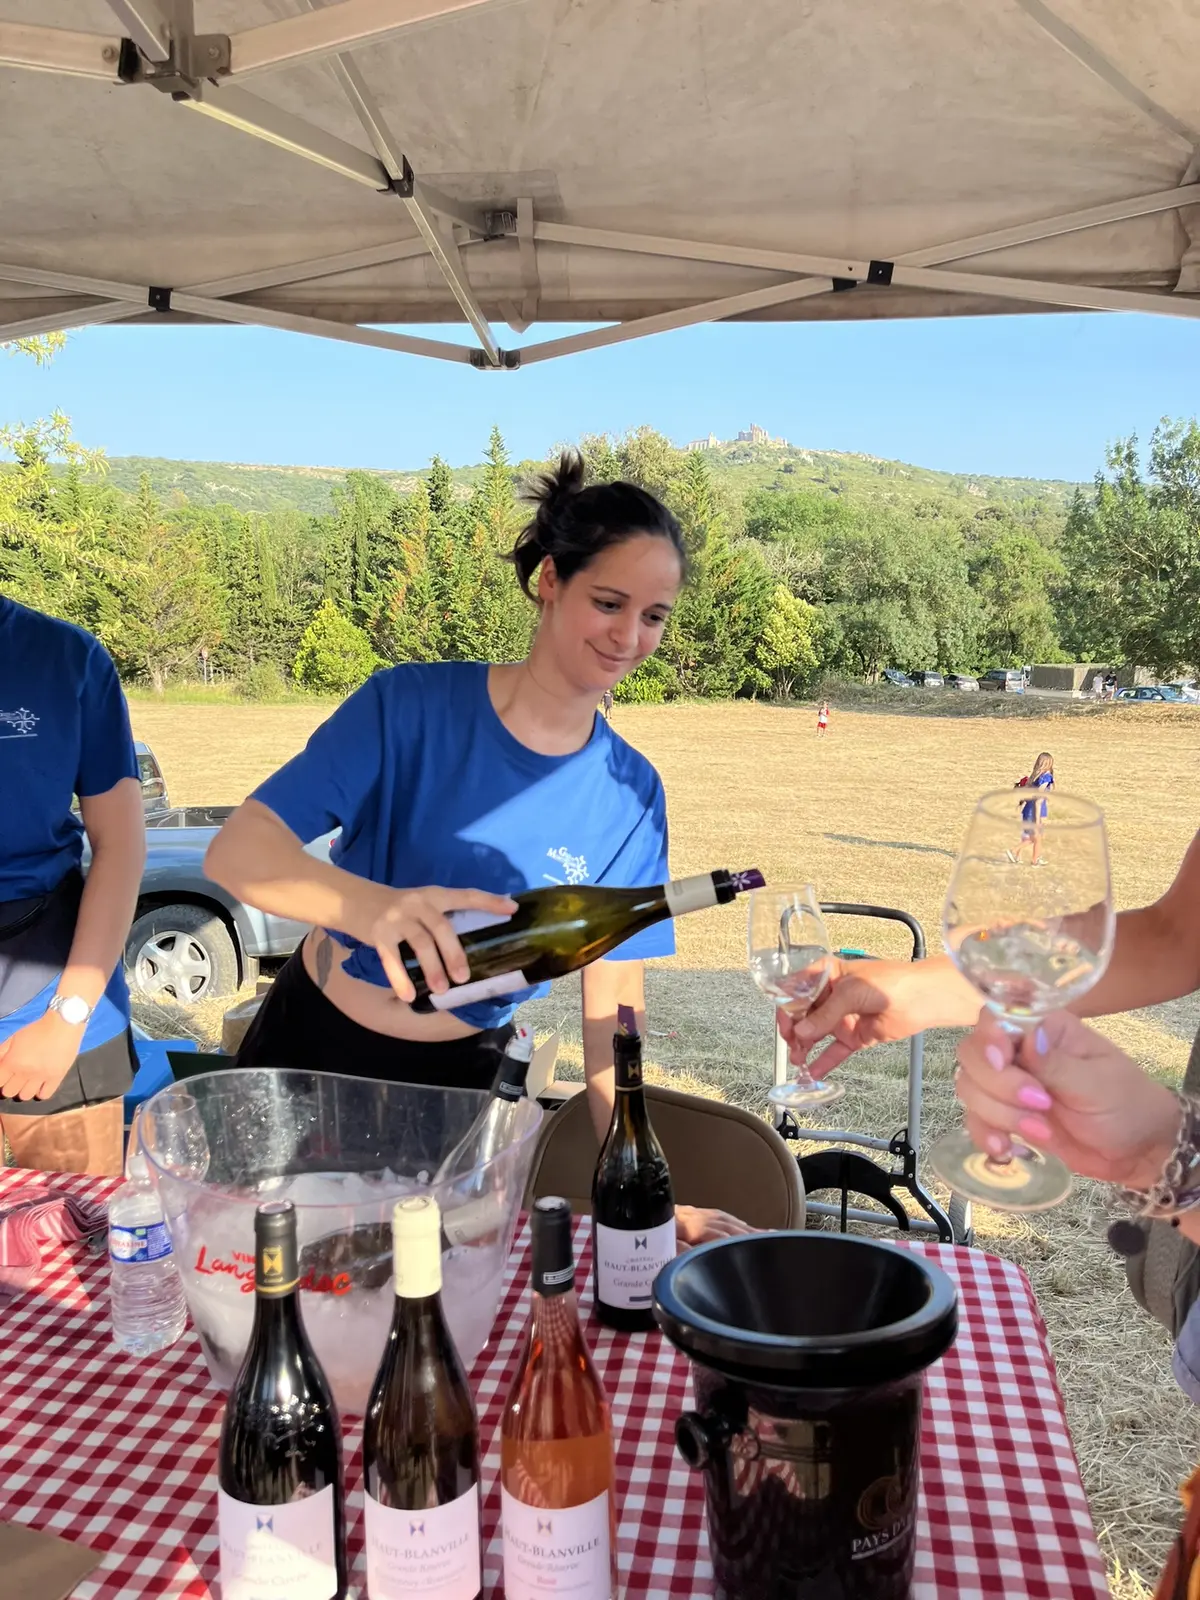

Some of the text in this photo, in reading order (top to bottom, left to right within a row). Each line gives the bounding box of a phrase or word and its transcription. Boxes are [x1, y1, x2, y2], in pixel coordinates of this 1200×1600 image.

[194, 1244, 352, 1296] Langdoc
[372, 1533, 469, 1559] HAUT-BLANVILLE
[505, 1526, 600, 1558] HAUT-BLANVILLE
[852, 1530, 889, 1553] PAYS
